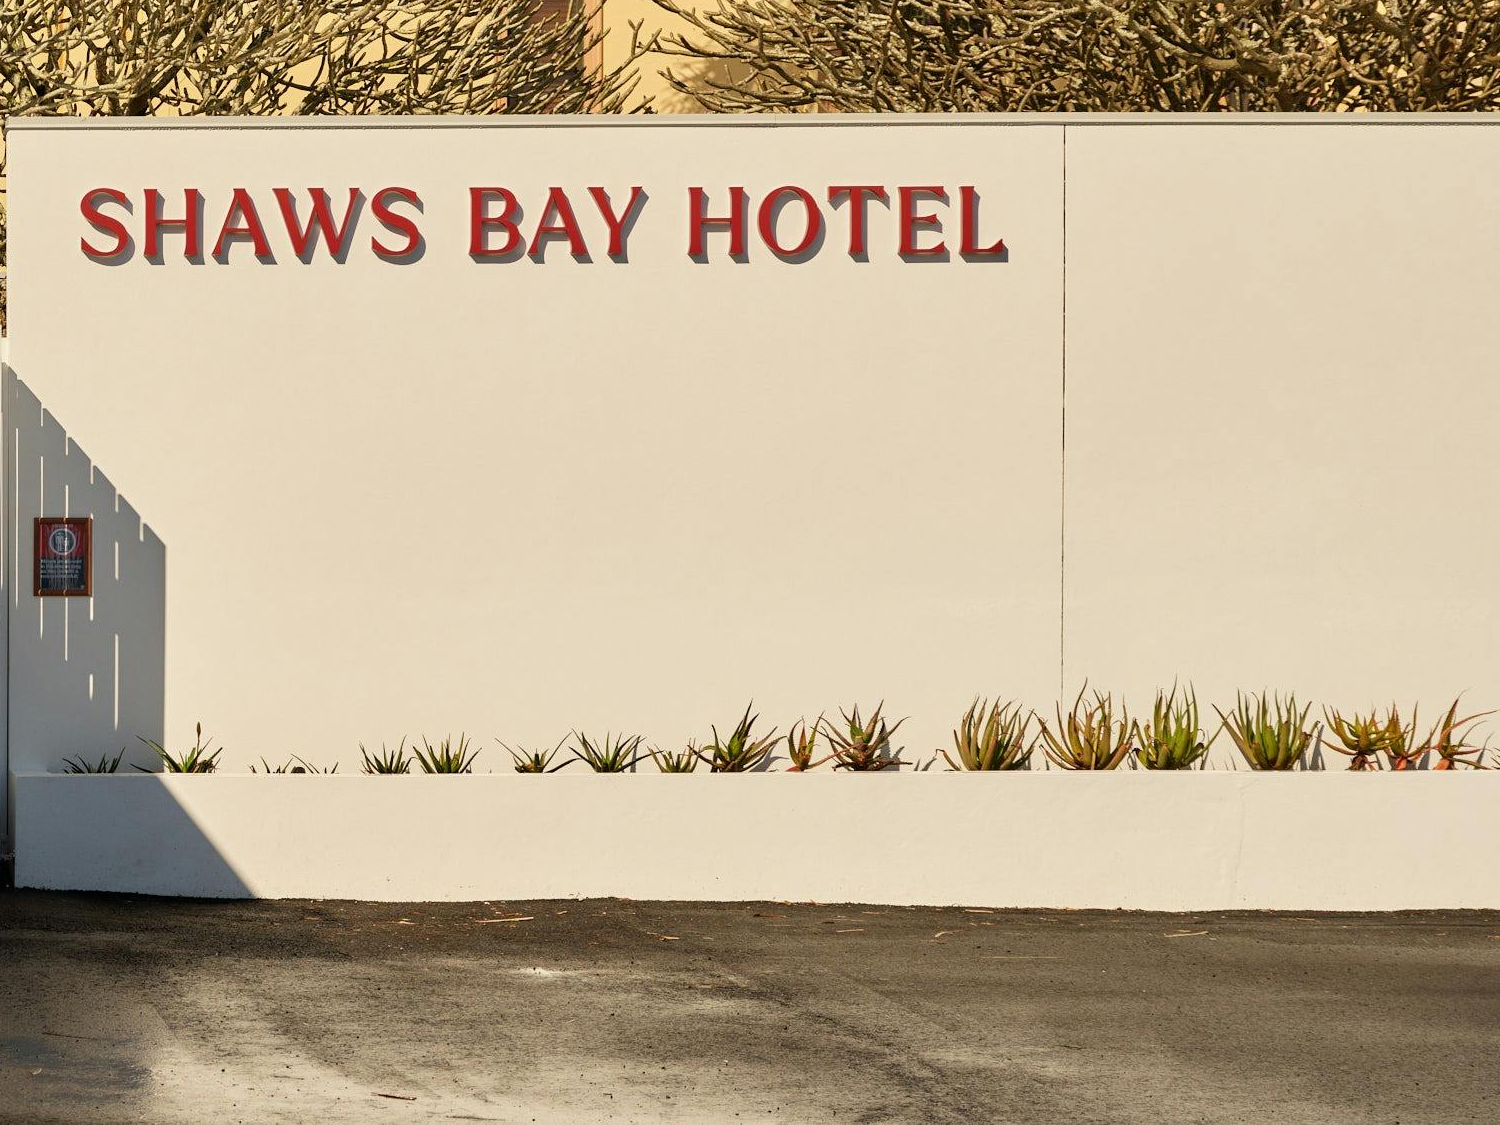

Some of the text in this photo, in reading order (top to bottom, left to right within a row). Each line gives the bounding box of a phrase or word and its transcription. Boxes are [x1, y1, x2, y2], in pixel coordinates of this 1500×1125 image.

[80, 185, 1007, 260] SHAWS BAY HOTEL
